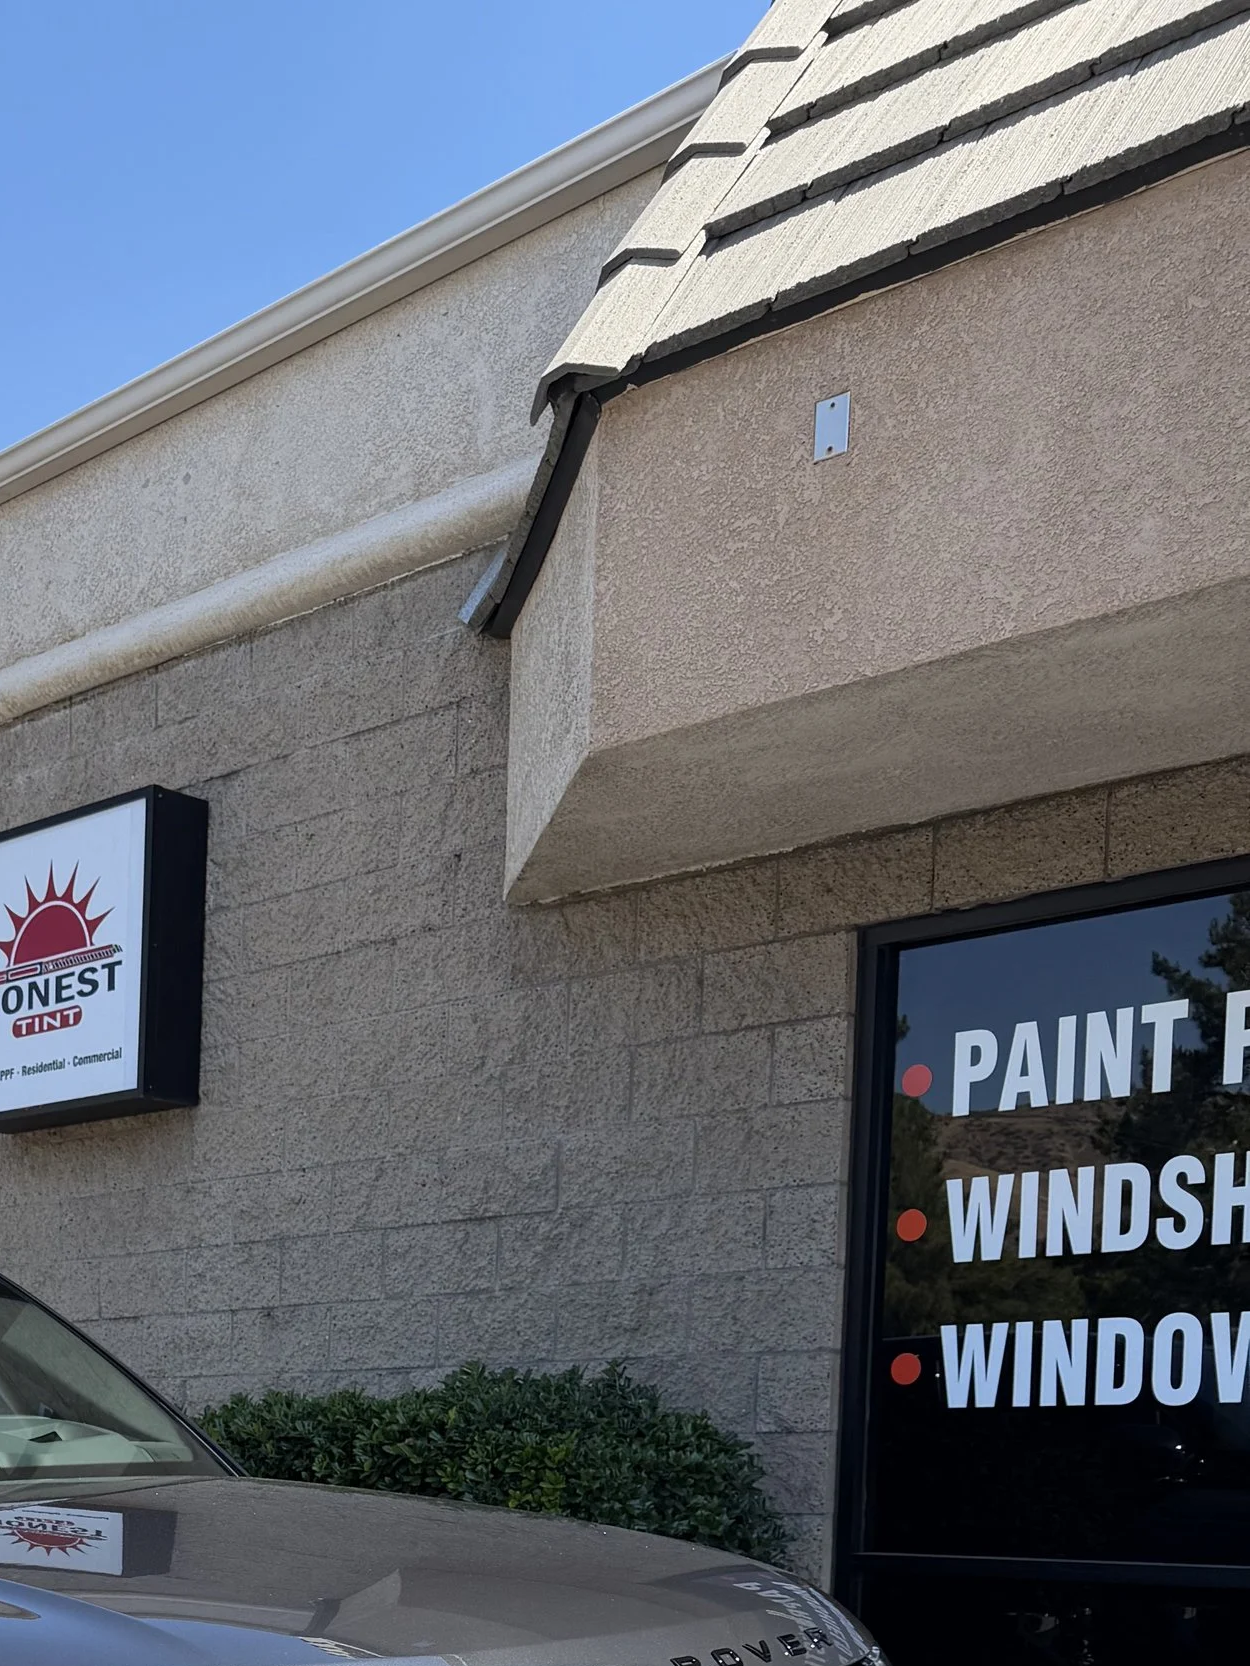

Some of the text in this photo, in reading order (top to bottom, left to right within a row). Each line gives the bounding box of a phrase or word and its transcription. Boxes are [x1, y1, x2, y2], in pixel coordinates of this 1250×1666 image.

[16, 1008, 80, 1035] TINT
[952, 998, 1190, 1117] PAINT
[0, 1068, 15, 1081] PPF
[22, 1059, 66, 1077] Residential
[73, 1047, 123, 1067] Commercial
[946, 1151, 1250, 1263] WINDSH
